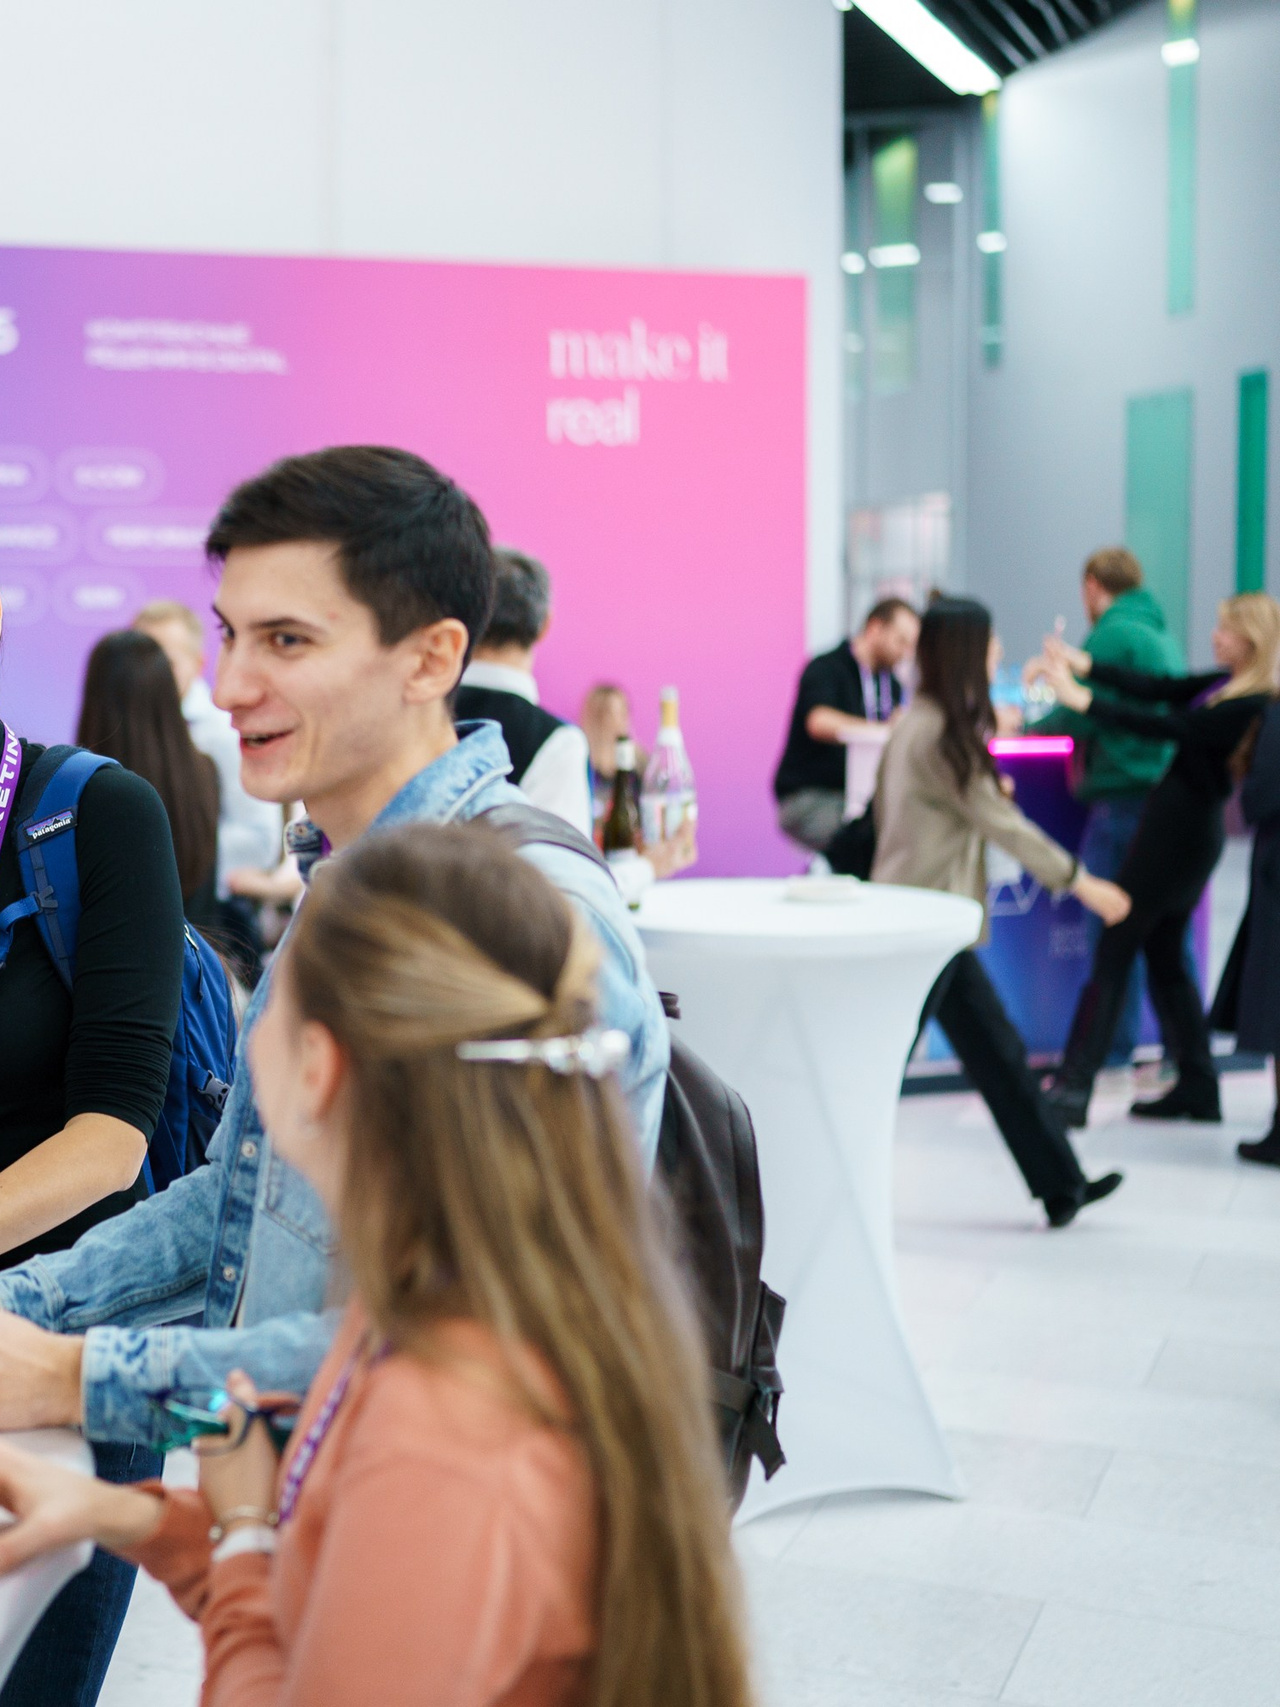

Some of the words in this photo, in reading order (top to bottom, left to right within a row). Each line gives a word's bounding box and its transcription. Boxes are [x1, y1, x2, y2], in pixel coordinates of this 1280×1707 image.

[548, 316, 692, 381] make
[697, 319, 729, 383] it
[546, 383, 640, 447] real
[32, 818, 72, 839] patagonia
